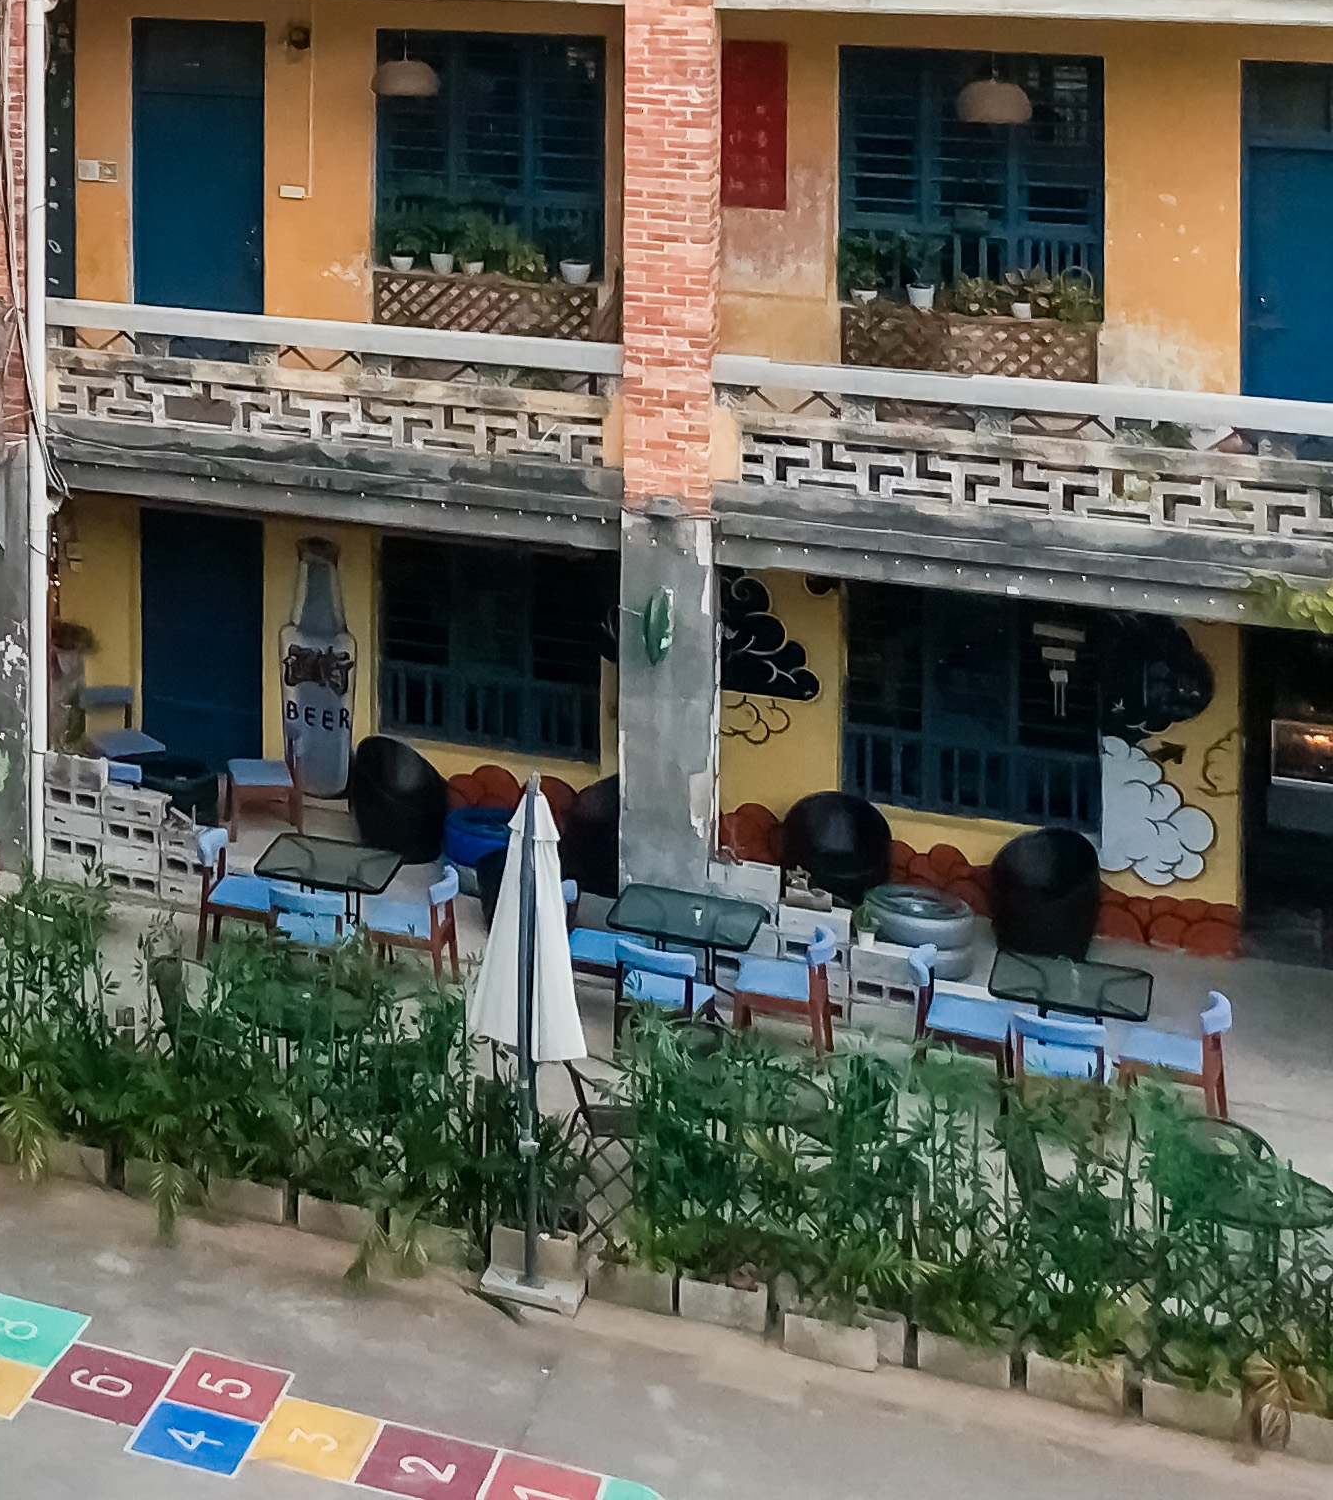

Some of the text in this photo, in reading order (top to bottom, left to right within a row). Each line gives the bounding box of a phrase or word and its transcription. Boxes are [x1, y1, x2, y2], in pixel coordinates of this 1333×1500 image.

[285, 699, 351, 731] BEER
[69, 1368, 134, 1399] 6
[197, 1370, 252, 1400] 5
[166, 1426, 225, 1451] 4
[287, 1426, 339, 1452] 3
[398, 1454, 458, 1484] 2
